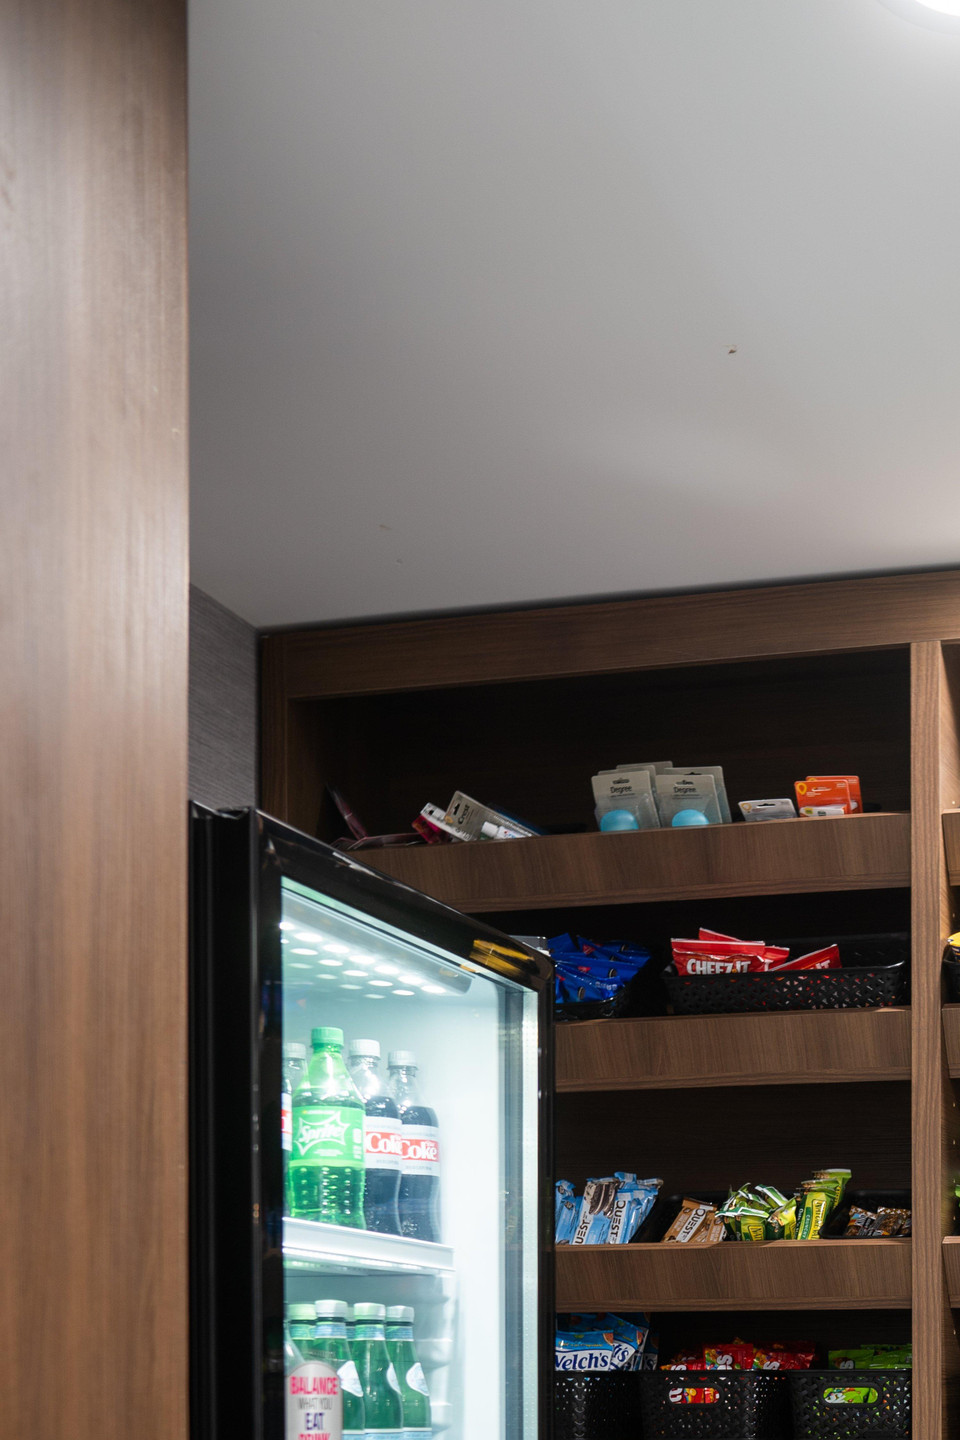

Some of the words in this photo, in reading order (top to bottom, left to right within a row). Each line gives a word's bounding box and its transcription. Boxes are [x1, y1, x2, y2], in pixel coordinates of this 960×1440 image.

[610, 785, 632, 794] Degree
[299, 1121, 345, 1143] Sprite
[610, 1200, 626, 1237] QUEST
[682, 1208, 706, 1236] QUEST
[575, 1220, 592, 1244] UEST
[289, 1376, 338, 1395] BALANCE
[298, 1397, 318, 1410] WHAT
[320, 1397, 333, 1410] YOU
[305, 1411, 325, 1431] EAT
